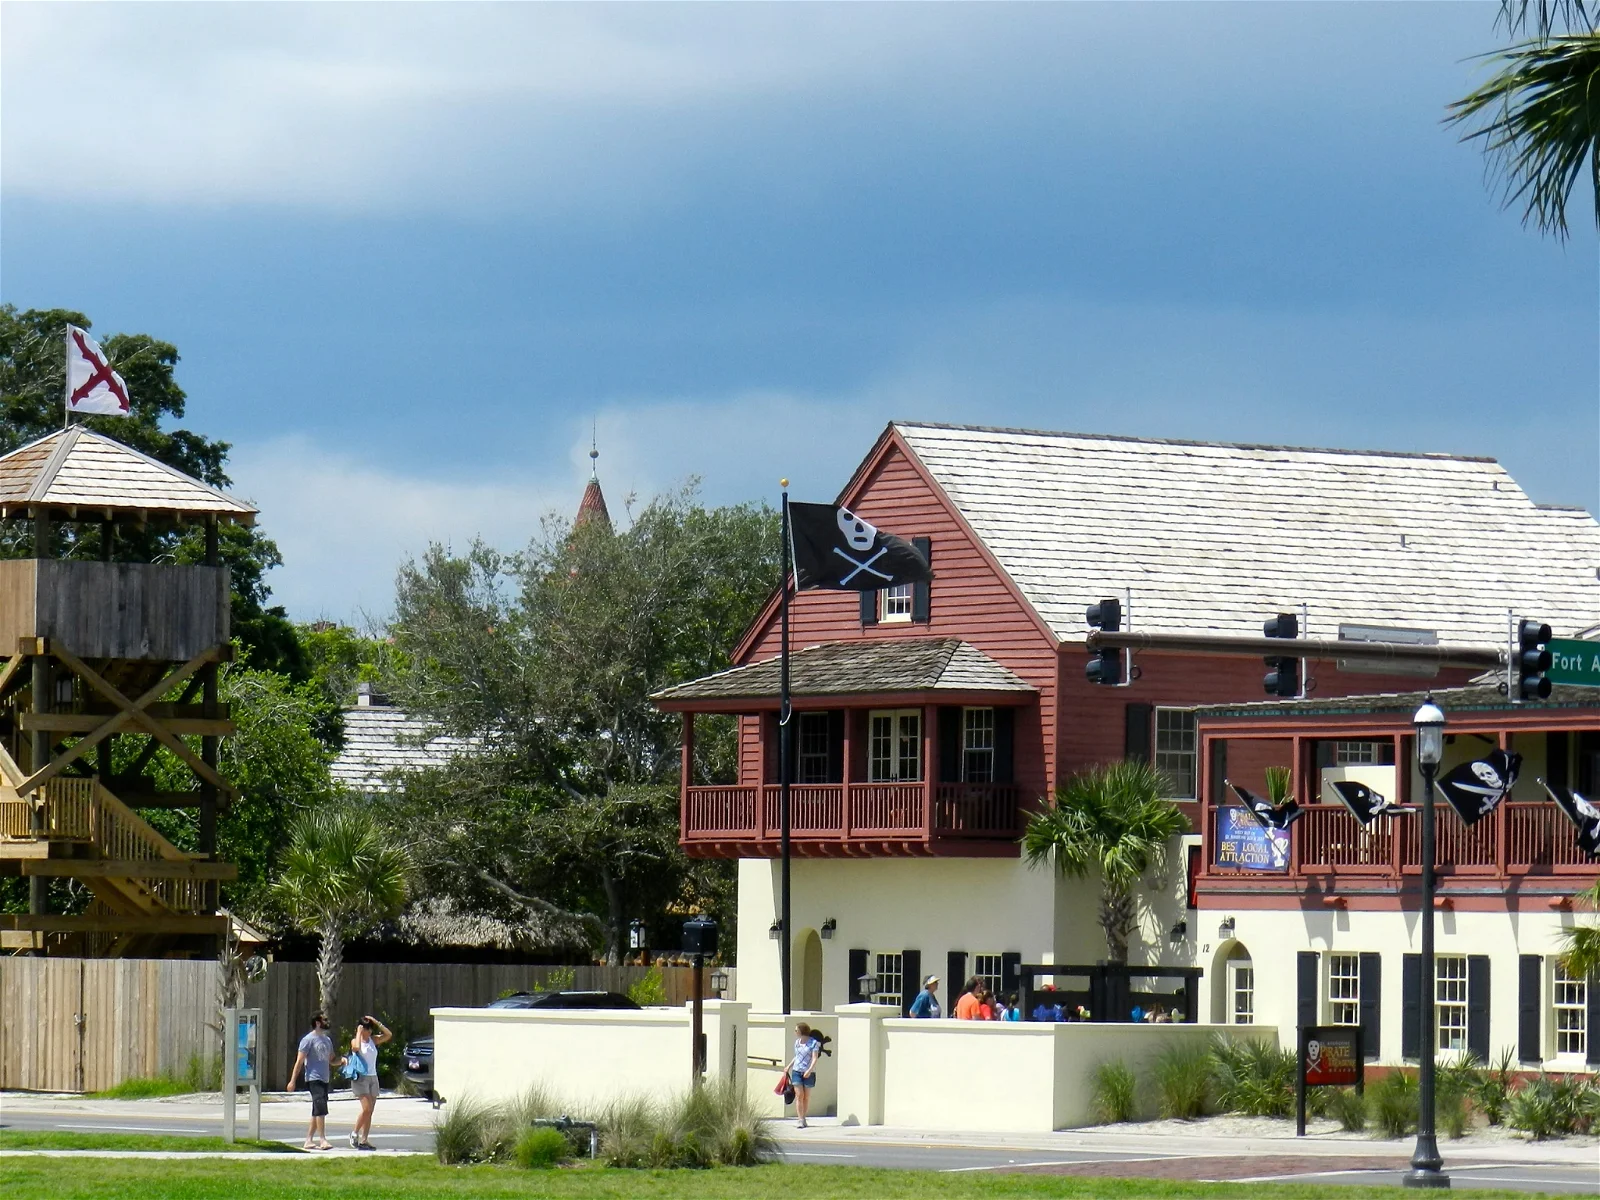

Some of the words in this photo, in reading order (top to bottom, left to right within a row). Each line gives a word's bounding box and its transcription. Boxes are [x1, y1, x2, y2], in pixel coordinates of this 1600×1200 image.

[1552, 652, 1582, 671] Fort
[1242, 842, 1269, 854] LOCAL
[1202, 943, 1210, 953] 12
